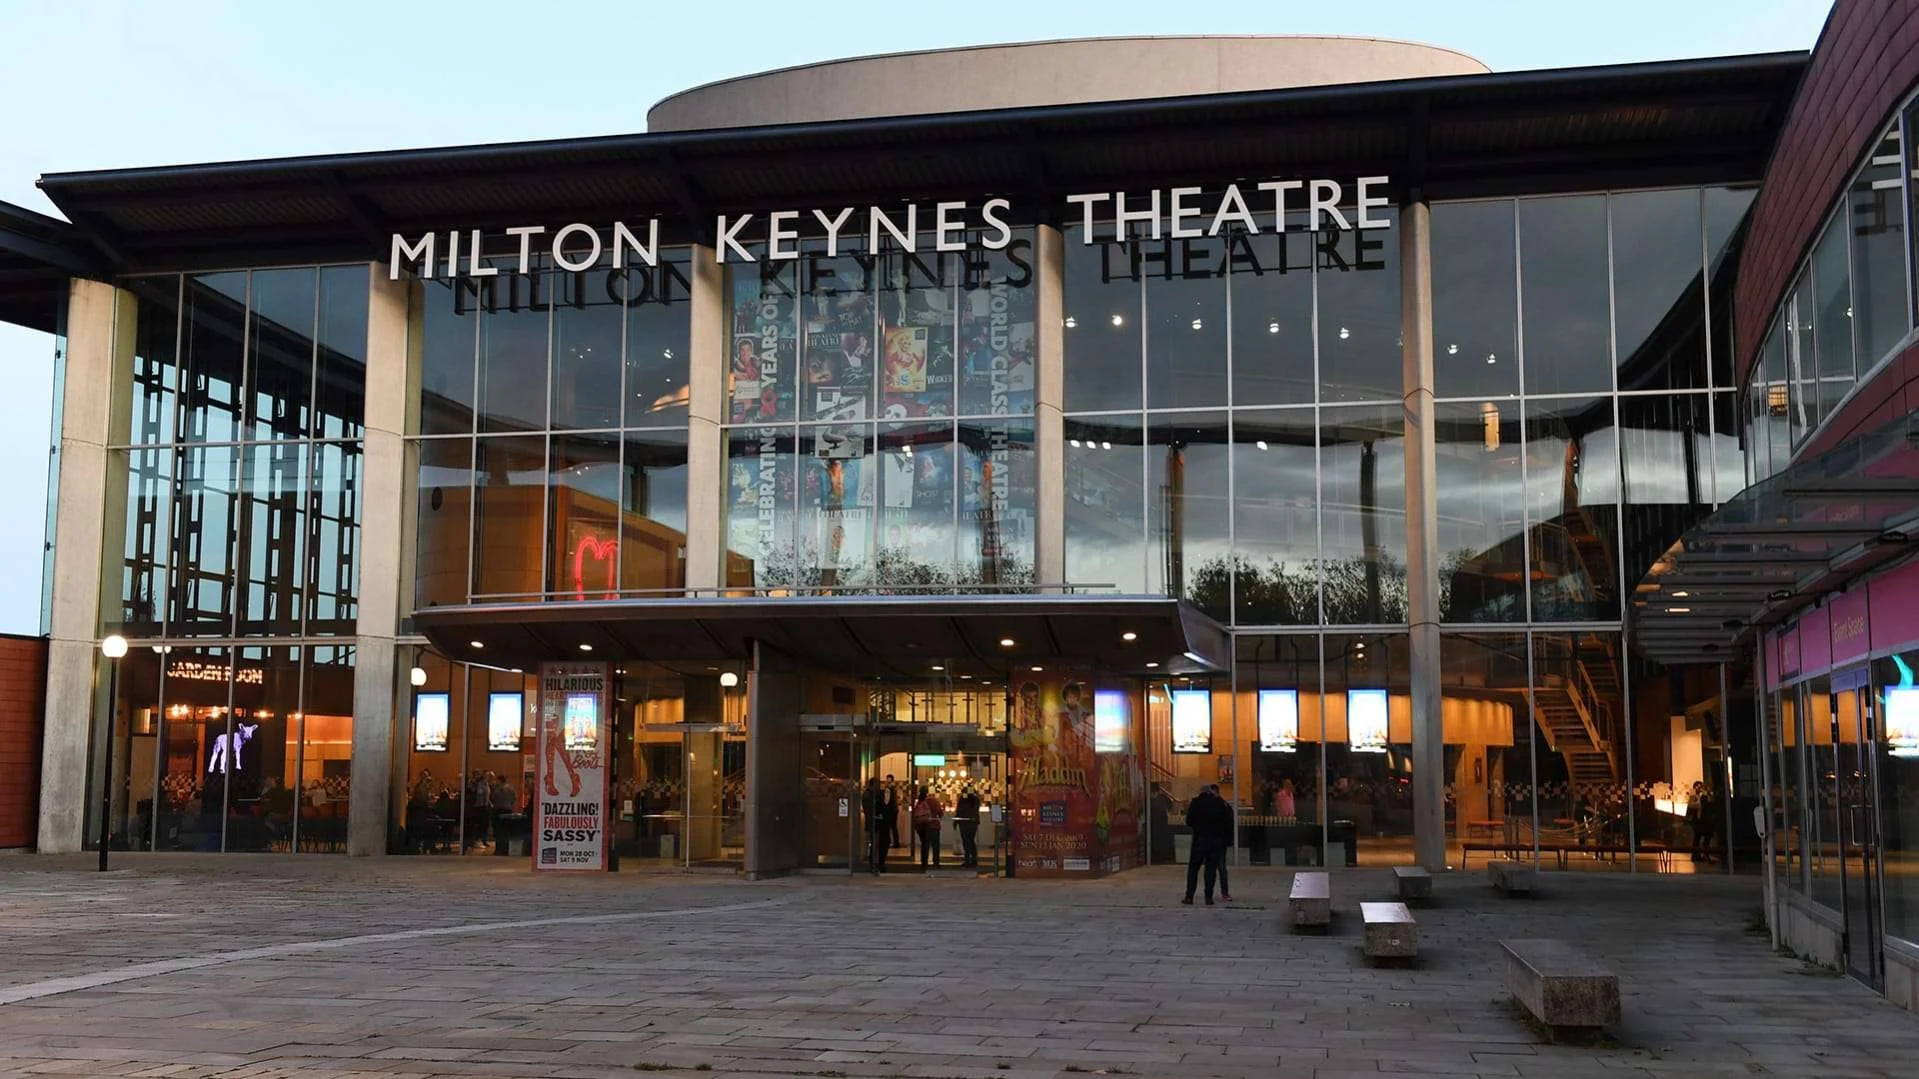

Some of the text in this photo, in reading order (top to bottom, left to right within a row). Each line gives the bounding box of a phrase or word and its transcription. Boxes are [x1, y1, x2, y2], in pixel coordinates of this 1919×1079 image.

[390, 176, 1390, 280] MILTON KEYNES THEATRE
[990, 276, 1008, 351] WORLD
[761, 325, 777, 388] YEARS
[991, 355, 1008, 415] CLASS
[760, 427, 777, 557] CELEBRATING
[991, 424, 1008, 511] THEATRE
[543, 816, 599, 829] FABULOUSLY
